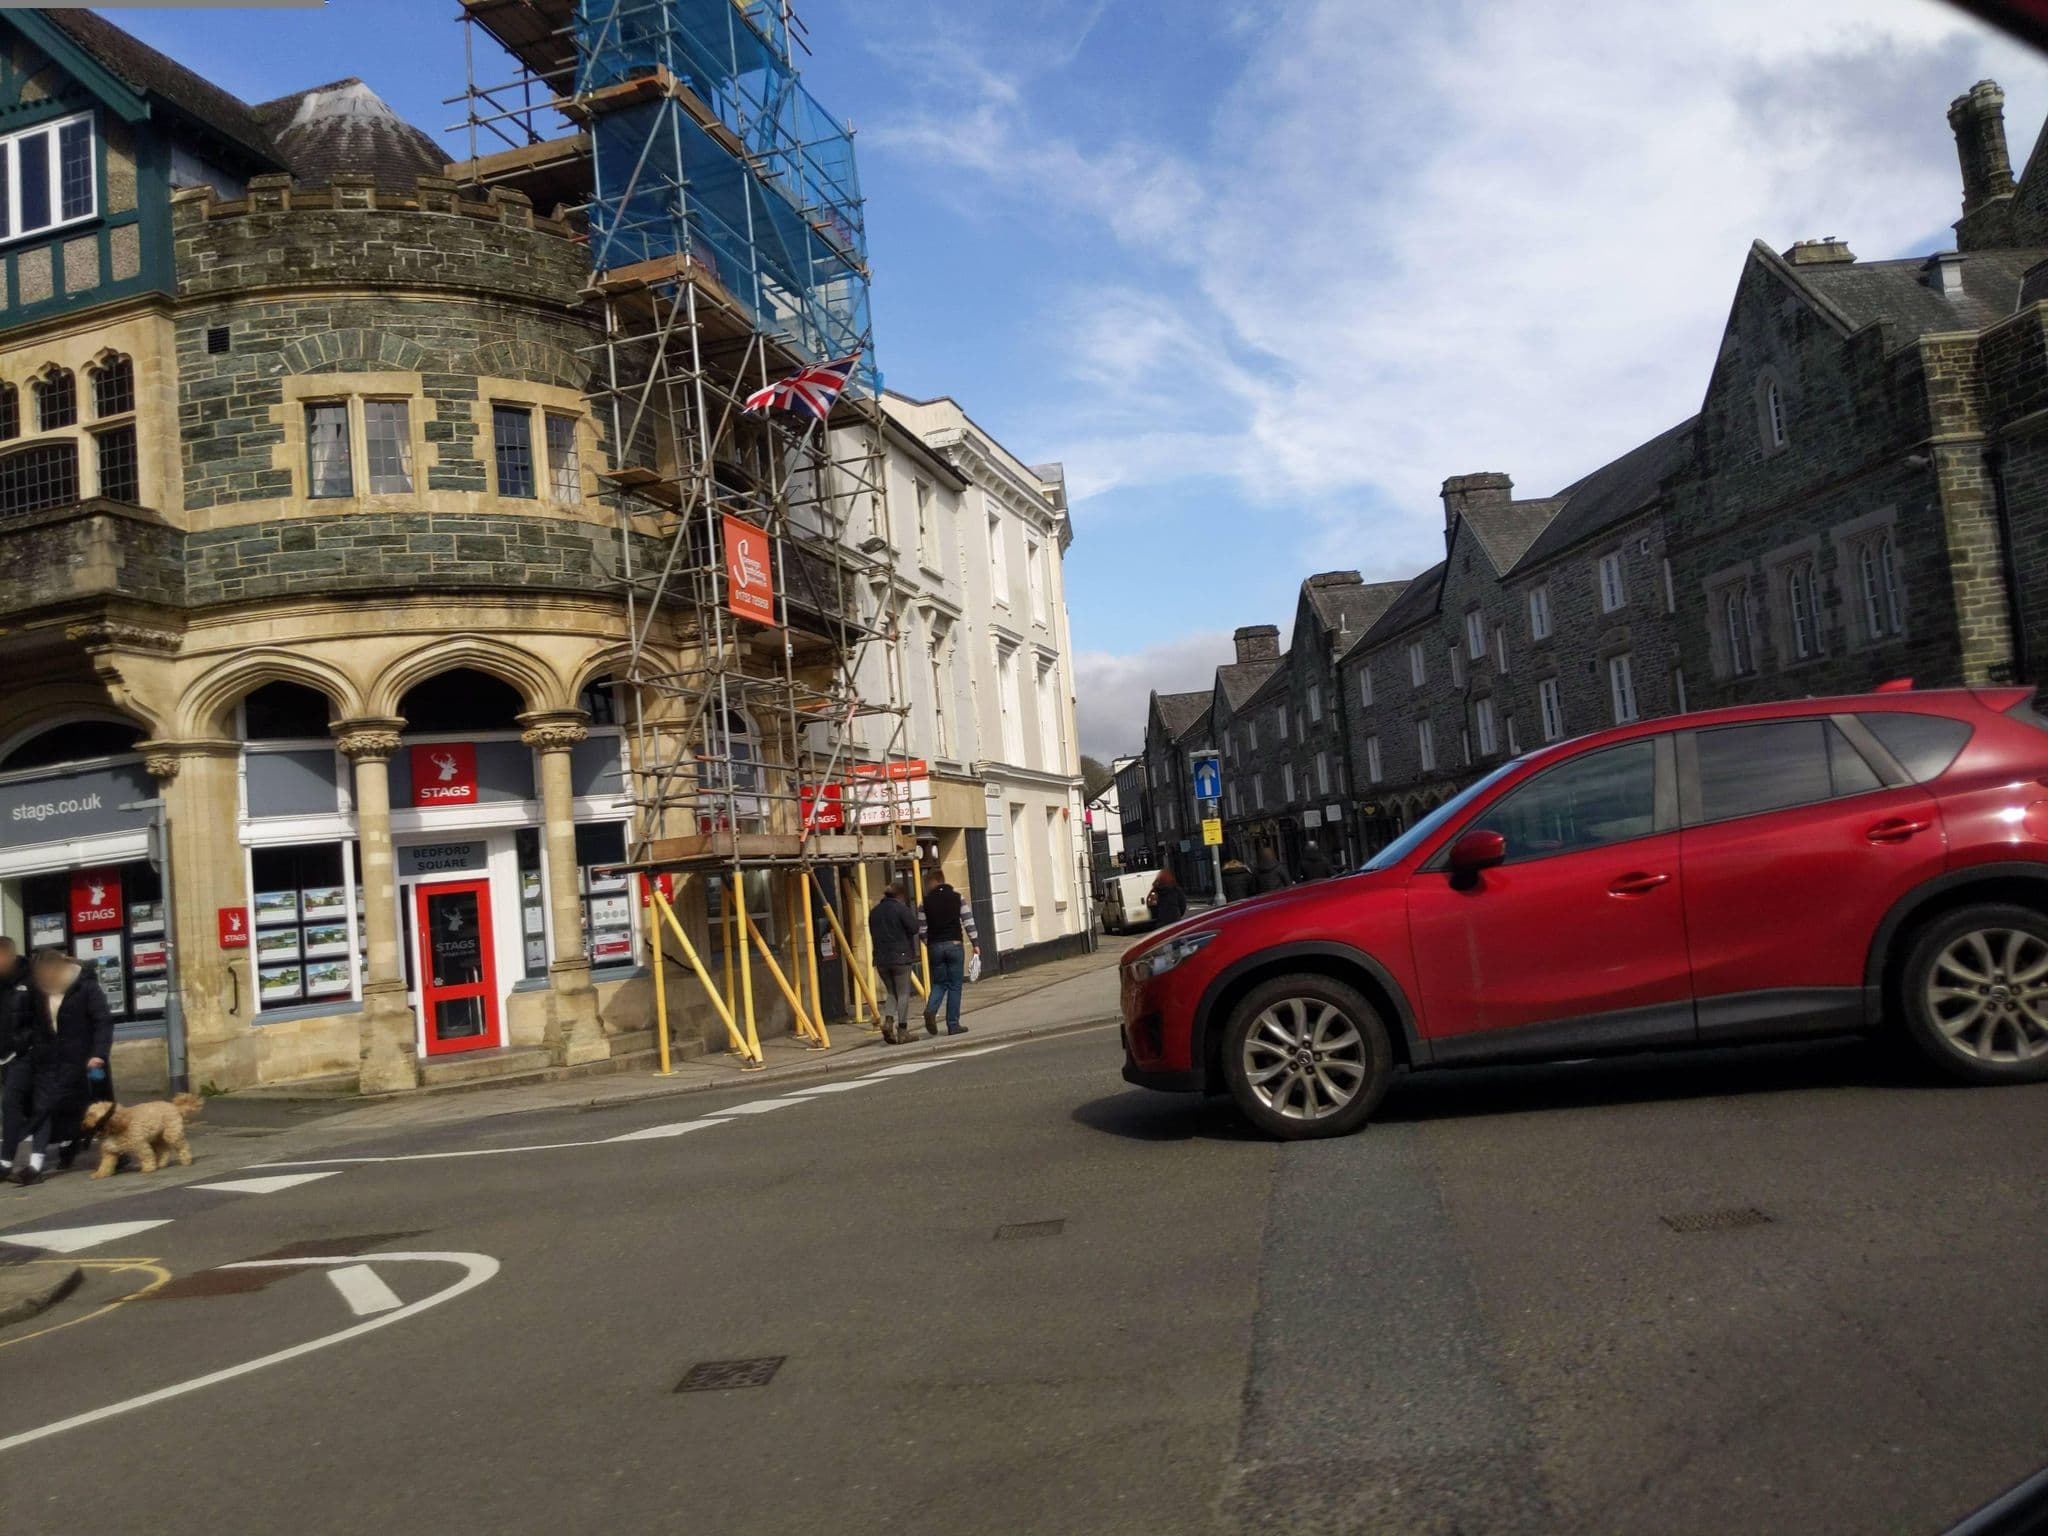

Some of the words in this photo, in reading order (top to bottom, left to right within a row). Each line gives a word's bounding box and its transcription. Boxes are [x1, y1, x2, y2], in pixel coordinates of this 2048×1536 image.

[420, 785, 471, 798] STAGS
[12, 793, 102, 821] stags.co.uk
[413, 845, 471, 859] BEDFORD
[417, 858, 468, 871] SQUARE
[77, 907, 116, 922] STAGS
[224, 933, 248, 942] STAGS
[435, 939, 476, 952] STAGS
